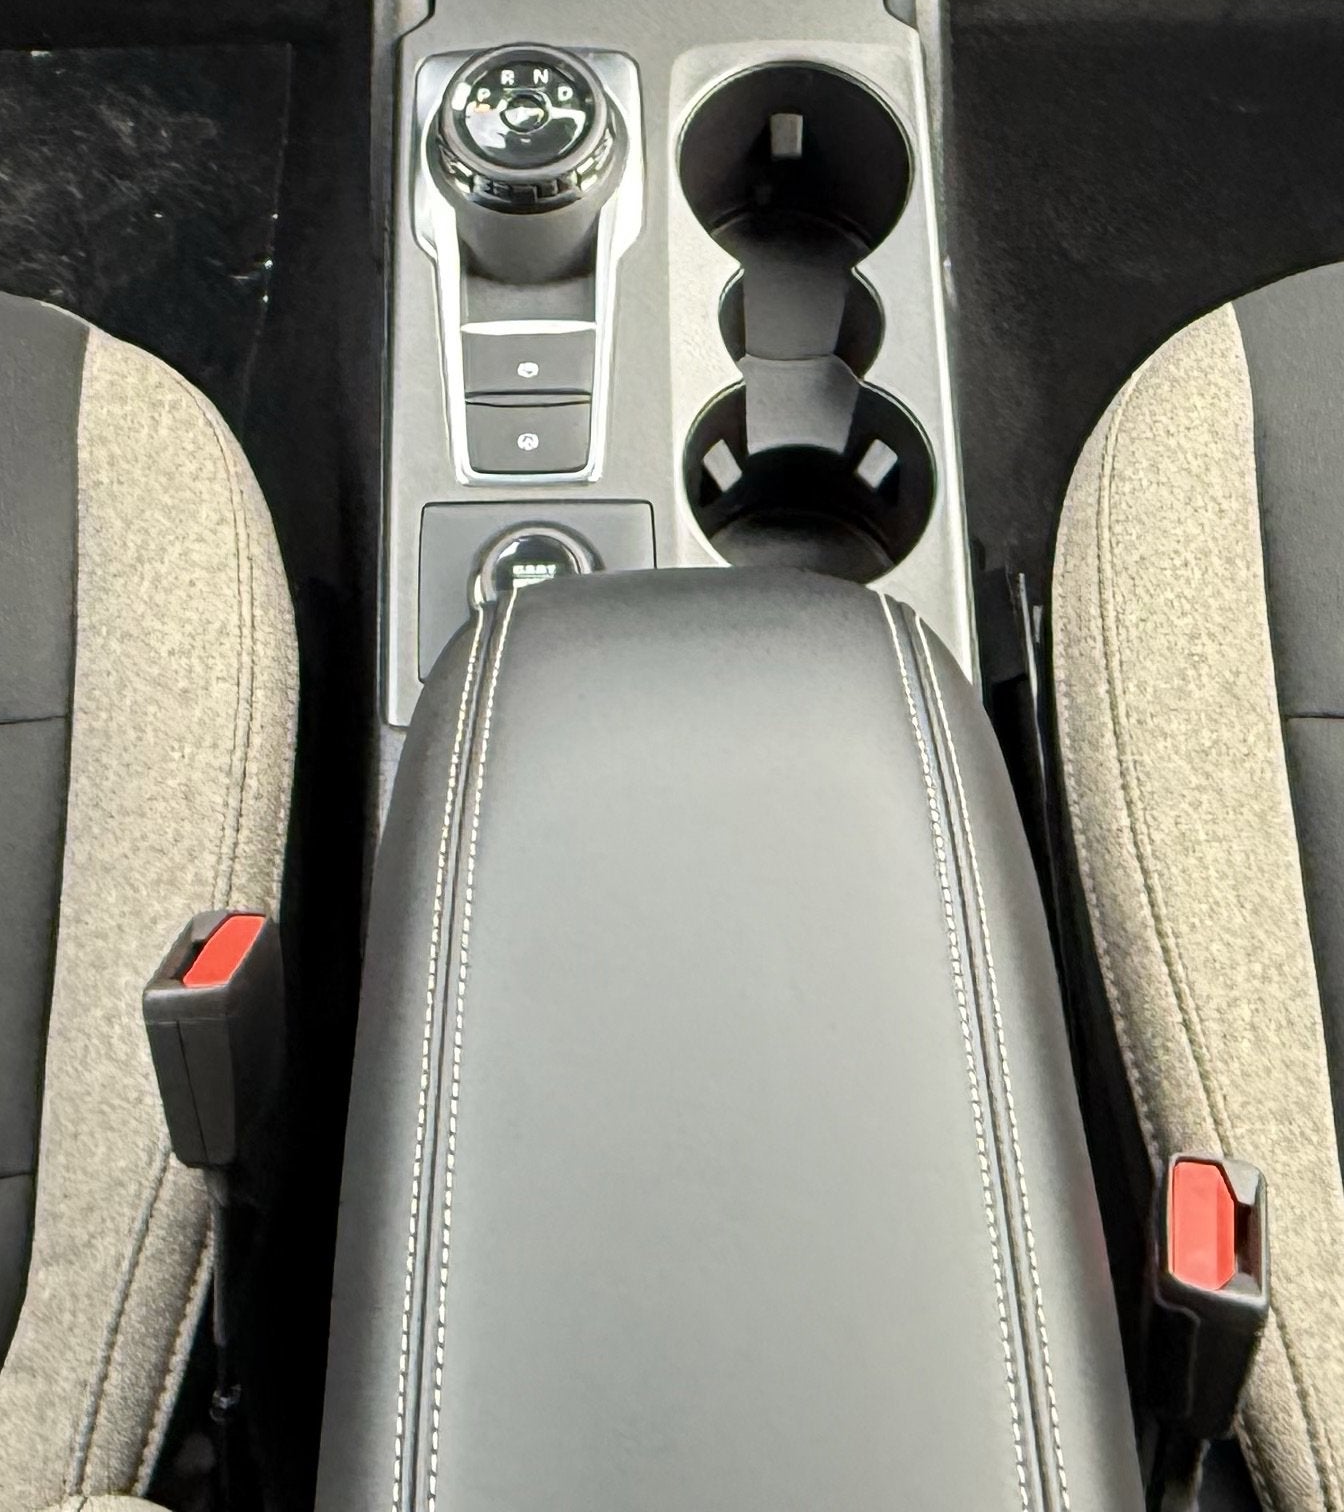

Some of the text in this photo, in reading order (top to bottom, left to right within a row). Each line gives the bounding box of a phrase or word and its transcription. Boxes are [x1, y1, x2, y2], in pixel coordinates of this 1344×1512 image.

[500, 68, 549, 86] R N
[477, 87, 491, 103] P
[557, 86, 574, 102] D
